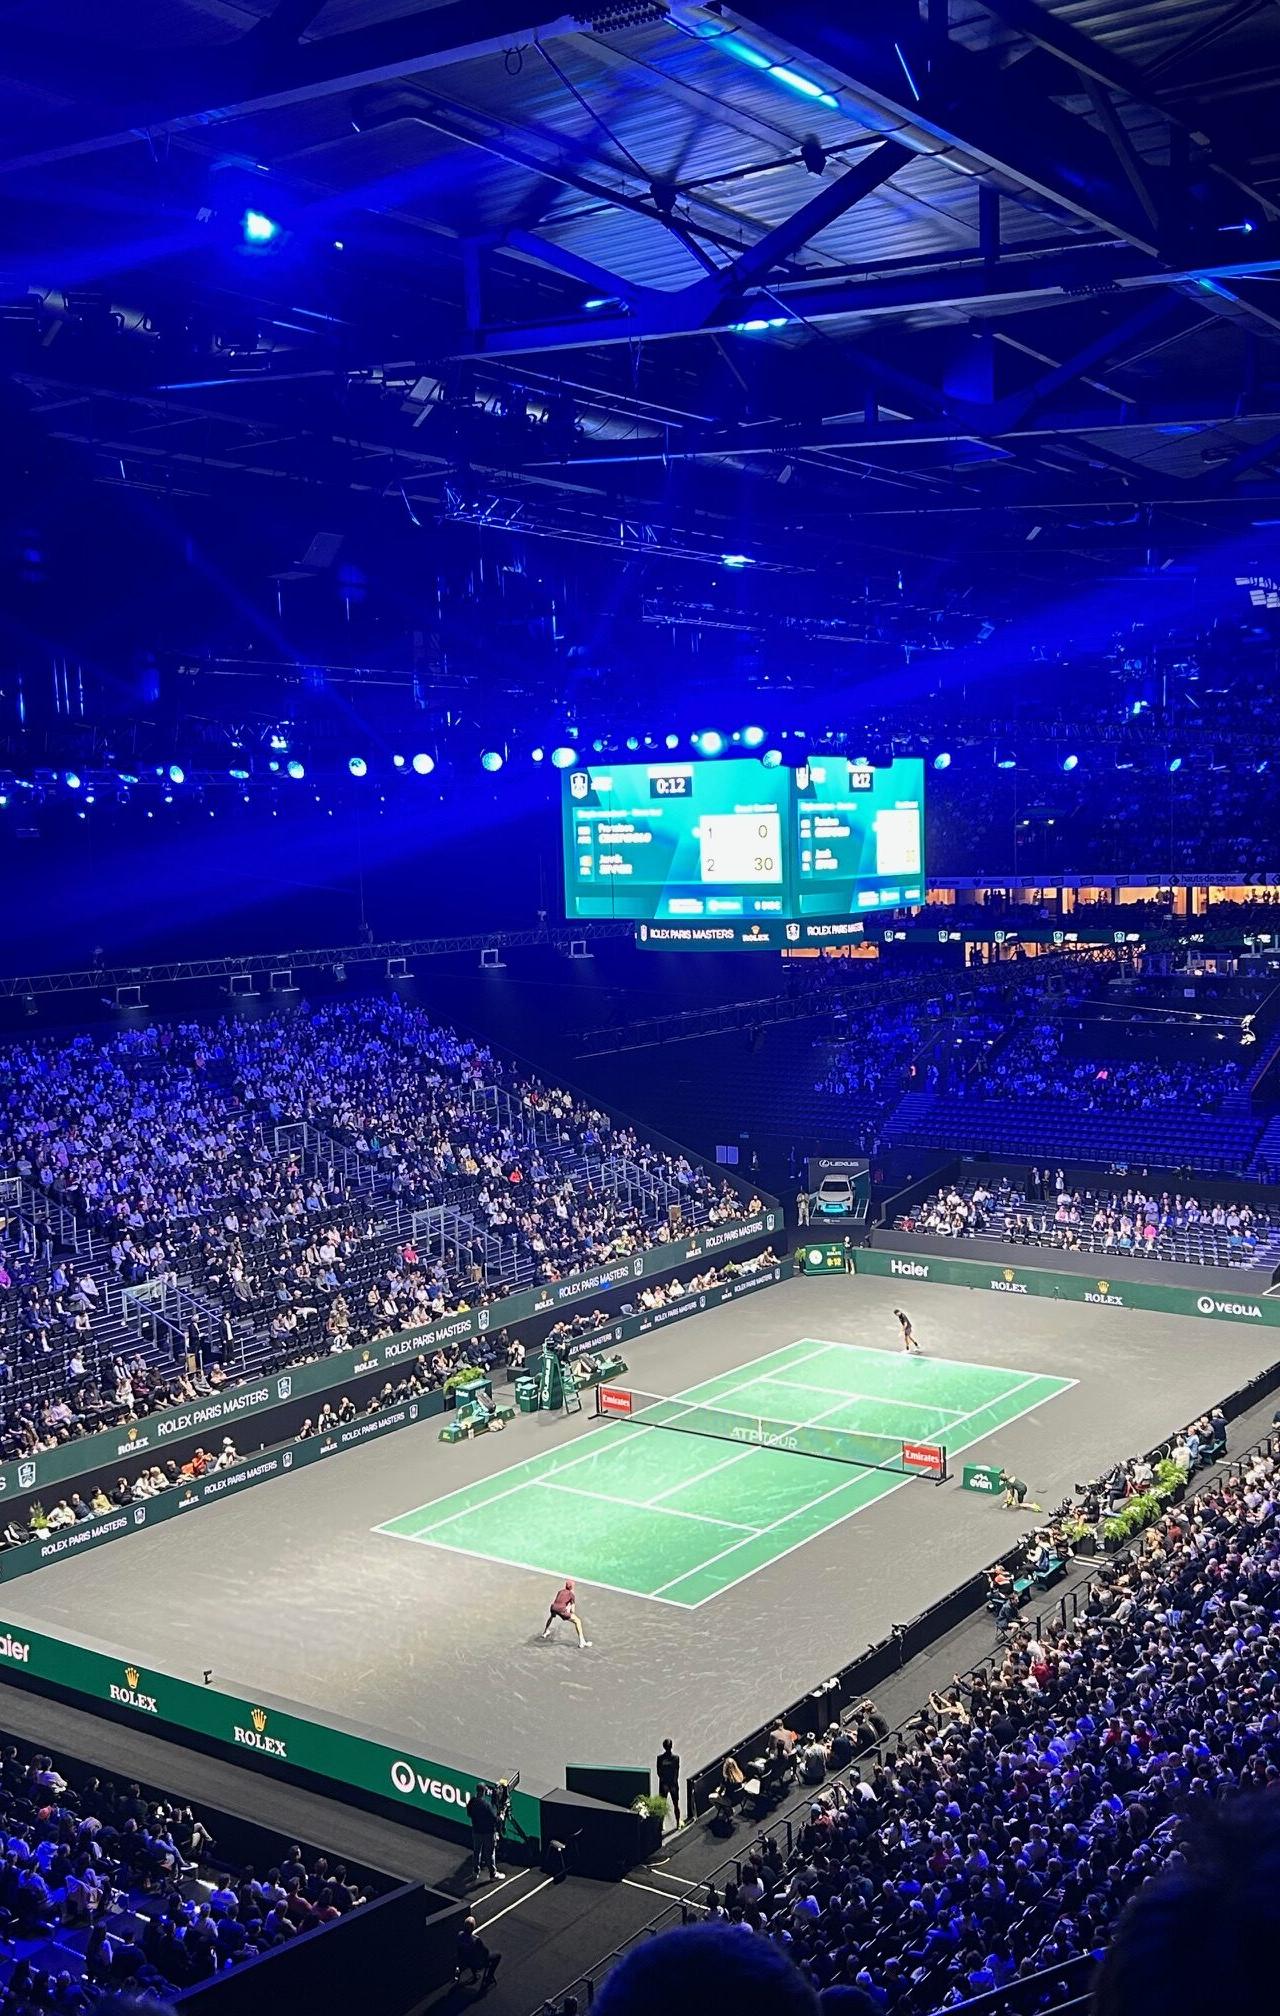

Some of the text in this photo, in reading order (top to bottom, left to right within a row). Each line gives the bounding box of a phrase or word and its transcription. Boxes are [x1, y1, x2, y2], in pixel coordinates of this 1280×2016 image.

[656, 777, 686, 794] 0:12
[759, 825, 768, 838] 0
[707, 858, 773, 872] 2 30
[670, 929, 691, 939] PARIS
[692, 929, 734, 939] MASTERS
[807, 925, 831, 936] ROLEX
[706, 1221, 763, 1248] ROLEX PARIS MASTERS
[891, 1260, 929, 1277] Haier
[559, 1266, 629, 1298] ROLEX PARIS MASTERS
[991, 1281, 1027, 1294] ROLEX
[1084, 1292, 1123, 1306] ROLEX
[1216, 1302, 1262, 1318] VEOLIA
[385, 1320, 472, 1358] ROLEX PARIS MASTERS
[570, 1344, 580, 1355] LEX
[354, 1359, 378, 1373] ROLEX
[157, 1389, 269, 1436] ROLEX PARIS MASTERS
[341, 1412, 405, 1442] ROLEX PARIS MASTERS
[118, 1437, 149, 1455] ROLEX
[731, 1427, 797, 1449] ATP TOUR
[905, 1450, 939, 1463] Emirates
[204, 1460, 277, 1495] ROLEX PARIS MASTERS
[970, 1478, 992, 1490] evian
[41, 1517, 128, 1557] ROLEX PARIS MASTERS
[0, 1634, 29, 1662] aier
[110, 1684, 158, 1713] ROLEX
[234, 1726, 287, 1758] ROLEX
[417, 1774, 471, 1808] VEOLI
